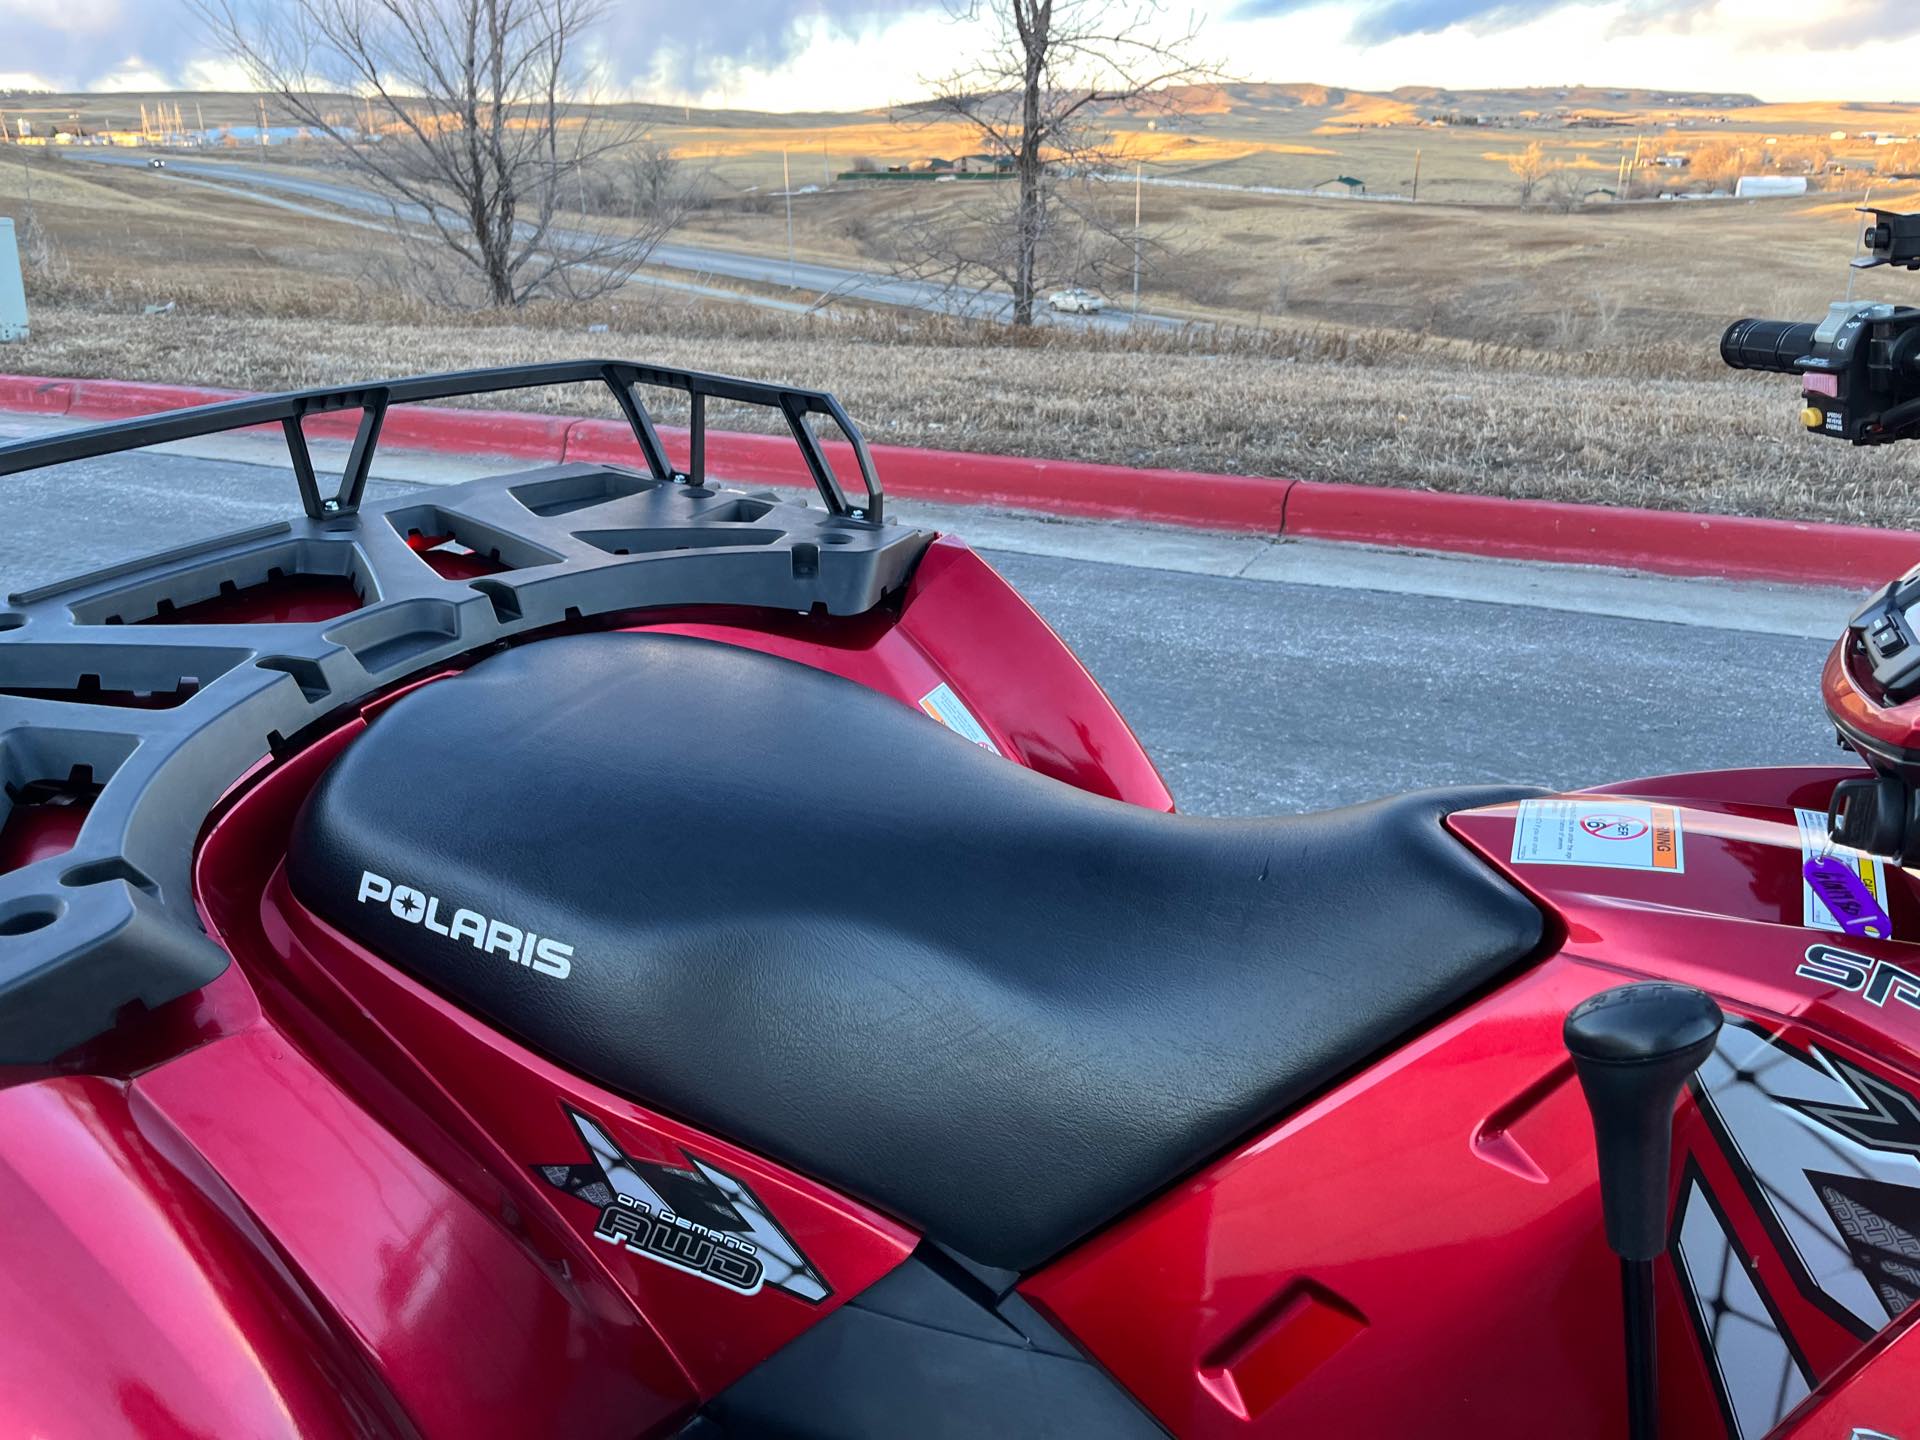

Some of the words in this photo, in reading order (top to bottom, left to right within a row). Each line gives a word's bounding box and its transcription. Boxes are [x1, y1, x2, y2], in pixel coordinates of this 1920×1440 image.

[357, 870, 575, 980] POLARIS
[597, 1206, 761, 1289] AWD
[616, 1193, 651, 1214] ON
[659, 1209, 758, 1256] DEMAND
